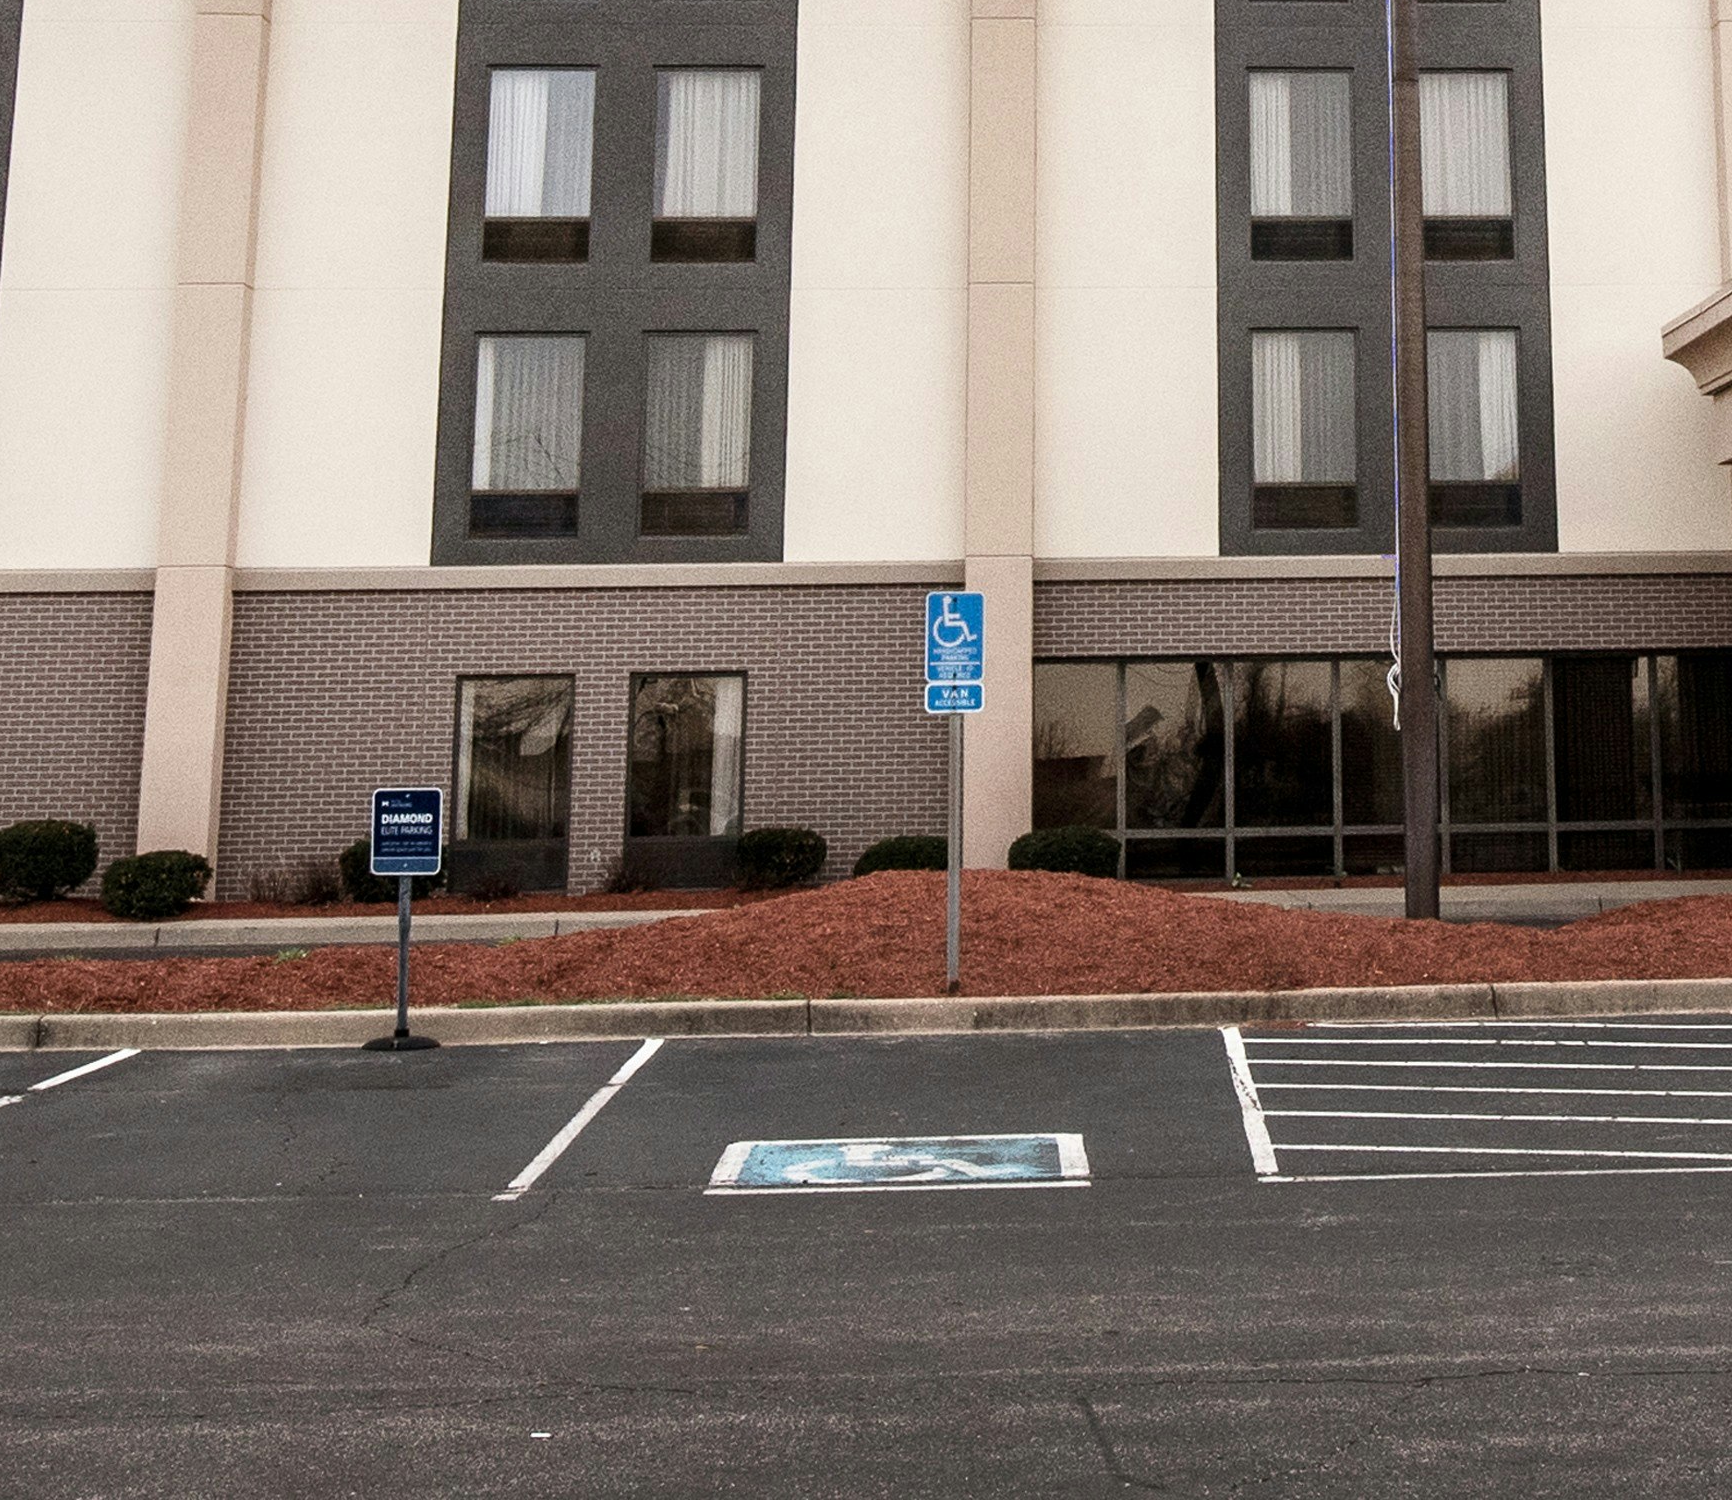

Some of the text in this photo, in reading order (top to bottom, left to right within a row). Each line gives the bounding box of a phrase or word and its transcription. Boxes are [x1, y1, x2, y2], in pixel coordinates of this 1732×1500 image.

[942, 688, 969, 699] VAN
[381, 813, 433, 825] DIAMOND
[380, 825, 433, 836] ELITE PARKING
